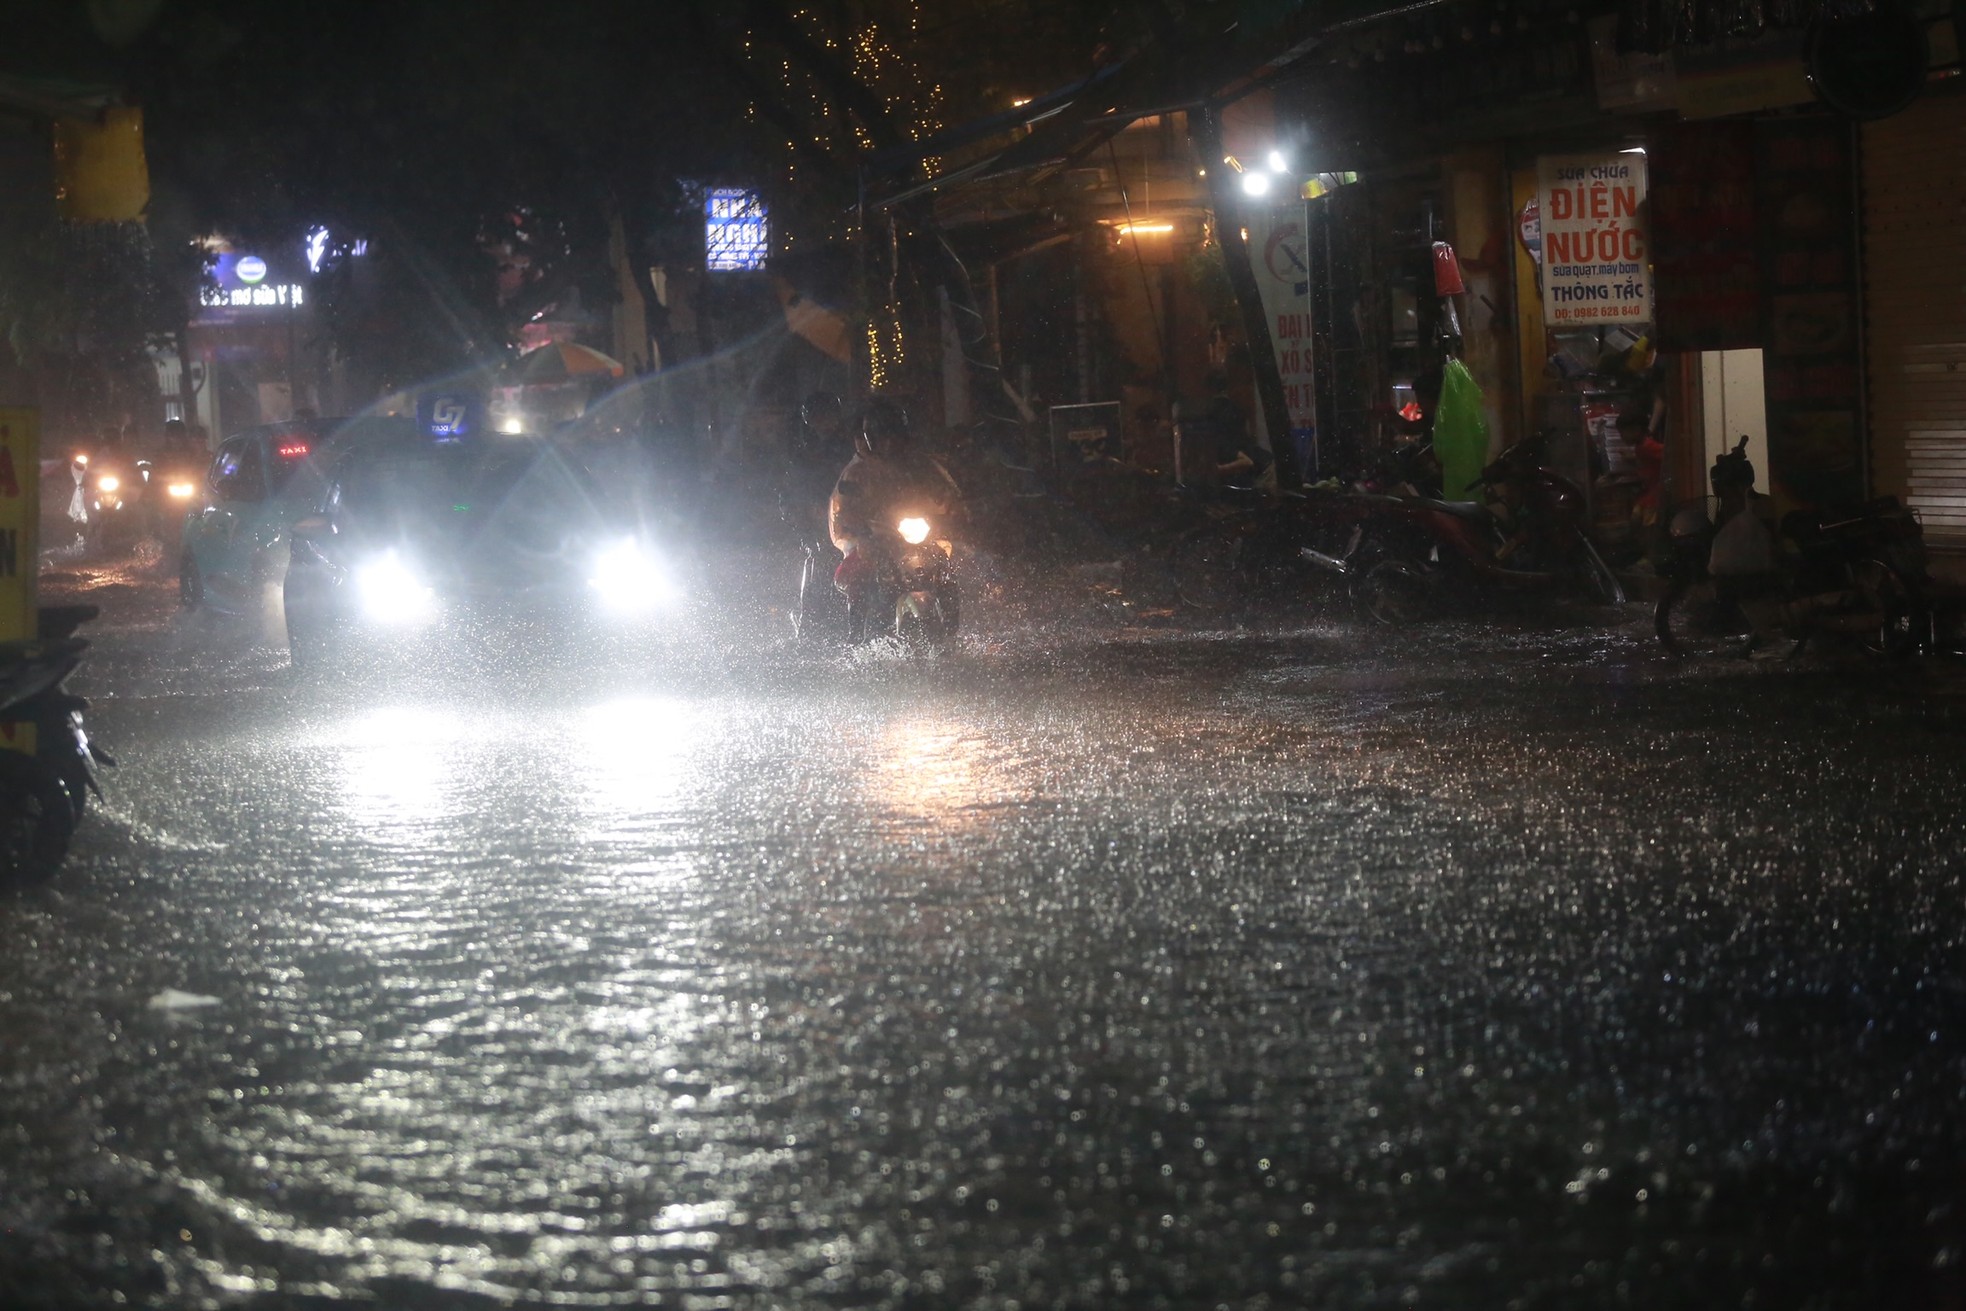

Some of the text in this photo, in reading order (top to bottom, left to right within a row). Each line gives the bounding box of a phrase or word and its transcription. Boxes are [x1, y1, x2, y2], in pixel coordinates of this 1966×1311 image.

[1549, 181, 1637, 224] ĐIỆN
[1547, 220, 1643, 264] NƯỚC
[1551, 275, 1643, 302] THÔNG TẮC
[1573, 307, 1599, 318] 0982
[1601, 306, 1619, 317] 628
[1621, 305, 1640, 316] 840
[280, 446, 307, 455] TAXI
